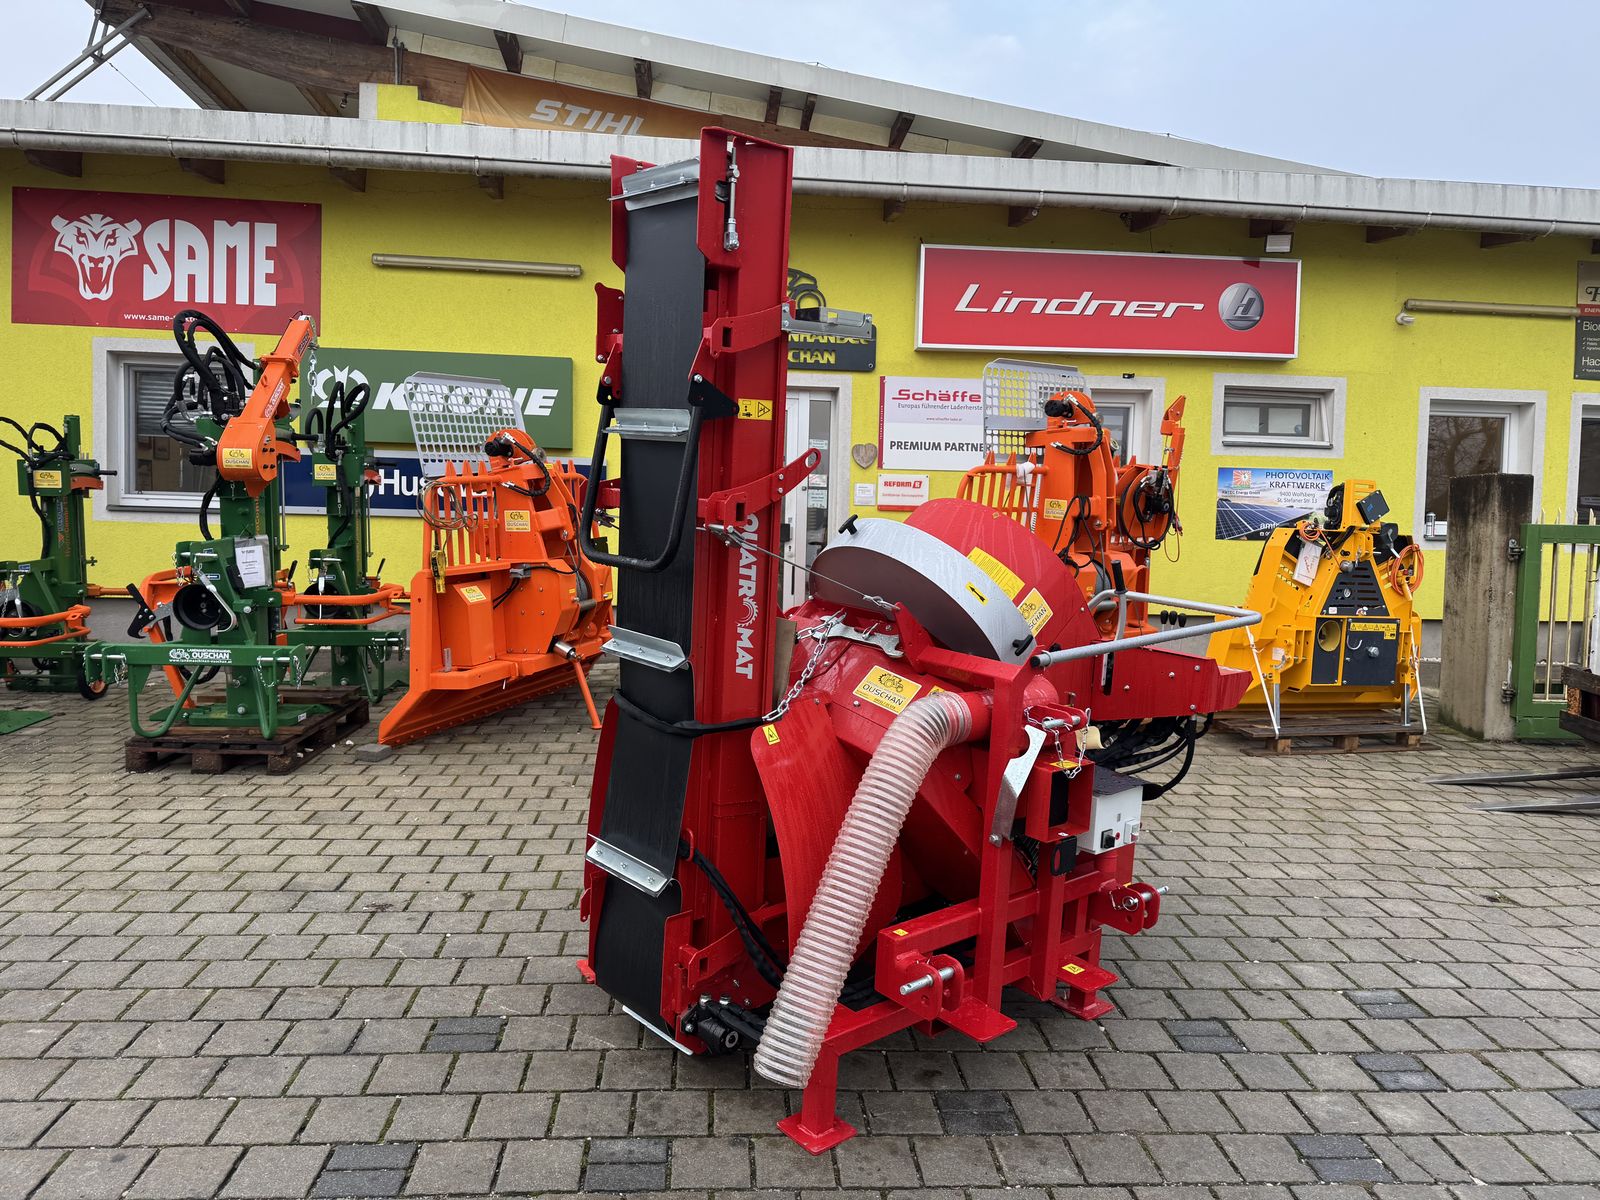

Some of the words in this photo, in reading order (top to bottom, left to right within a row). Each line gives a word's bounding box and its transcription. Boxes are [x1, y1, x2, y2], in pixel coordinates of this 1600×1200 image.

[142, 218, 278, 307] SAME
[954, 283, 1205, 319] Lindner
[891, 389, 982, 403] Schäffe
[897, 402, 920, 410] Europas
[921, 402, 949, 410] führender
[889, 440, 942, 451] PREMIUM
[1265, 471, 1330, 481] PHOTOVOLTAIK
[1269, 481, 1326, 490] KRAFTWERKE
[862, 684, 904, 706] OUSCHAN
